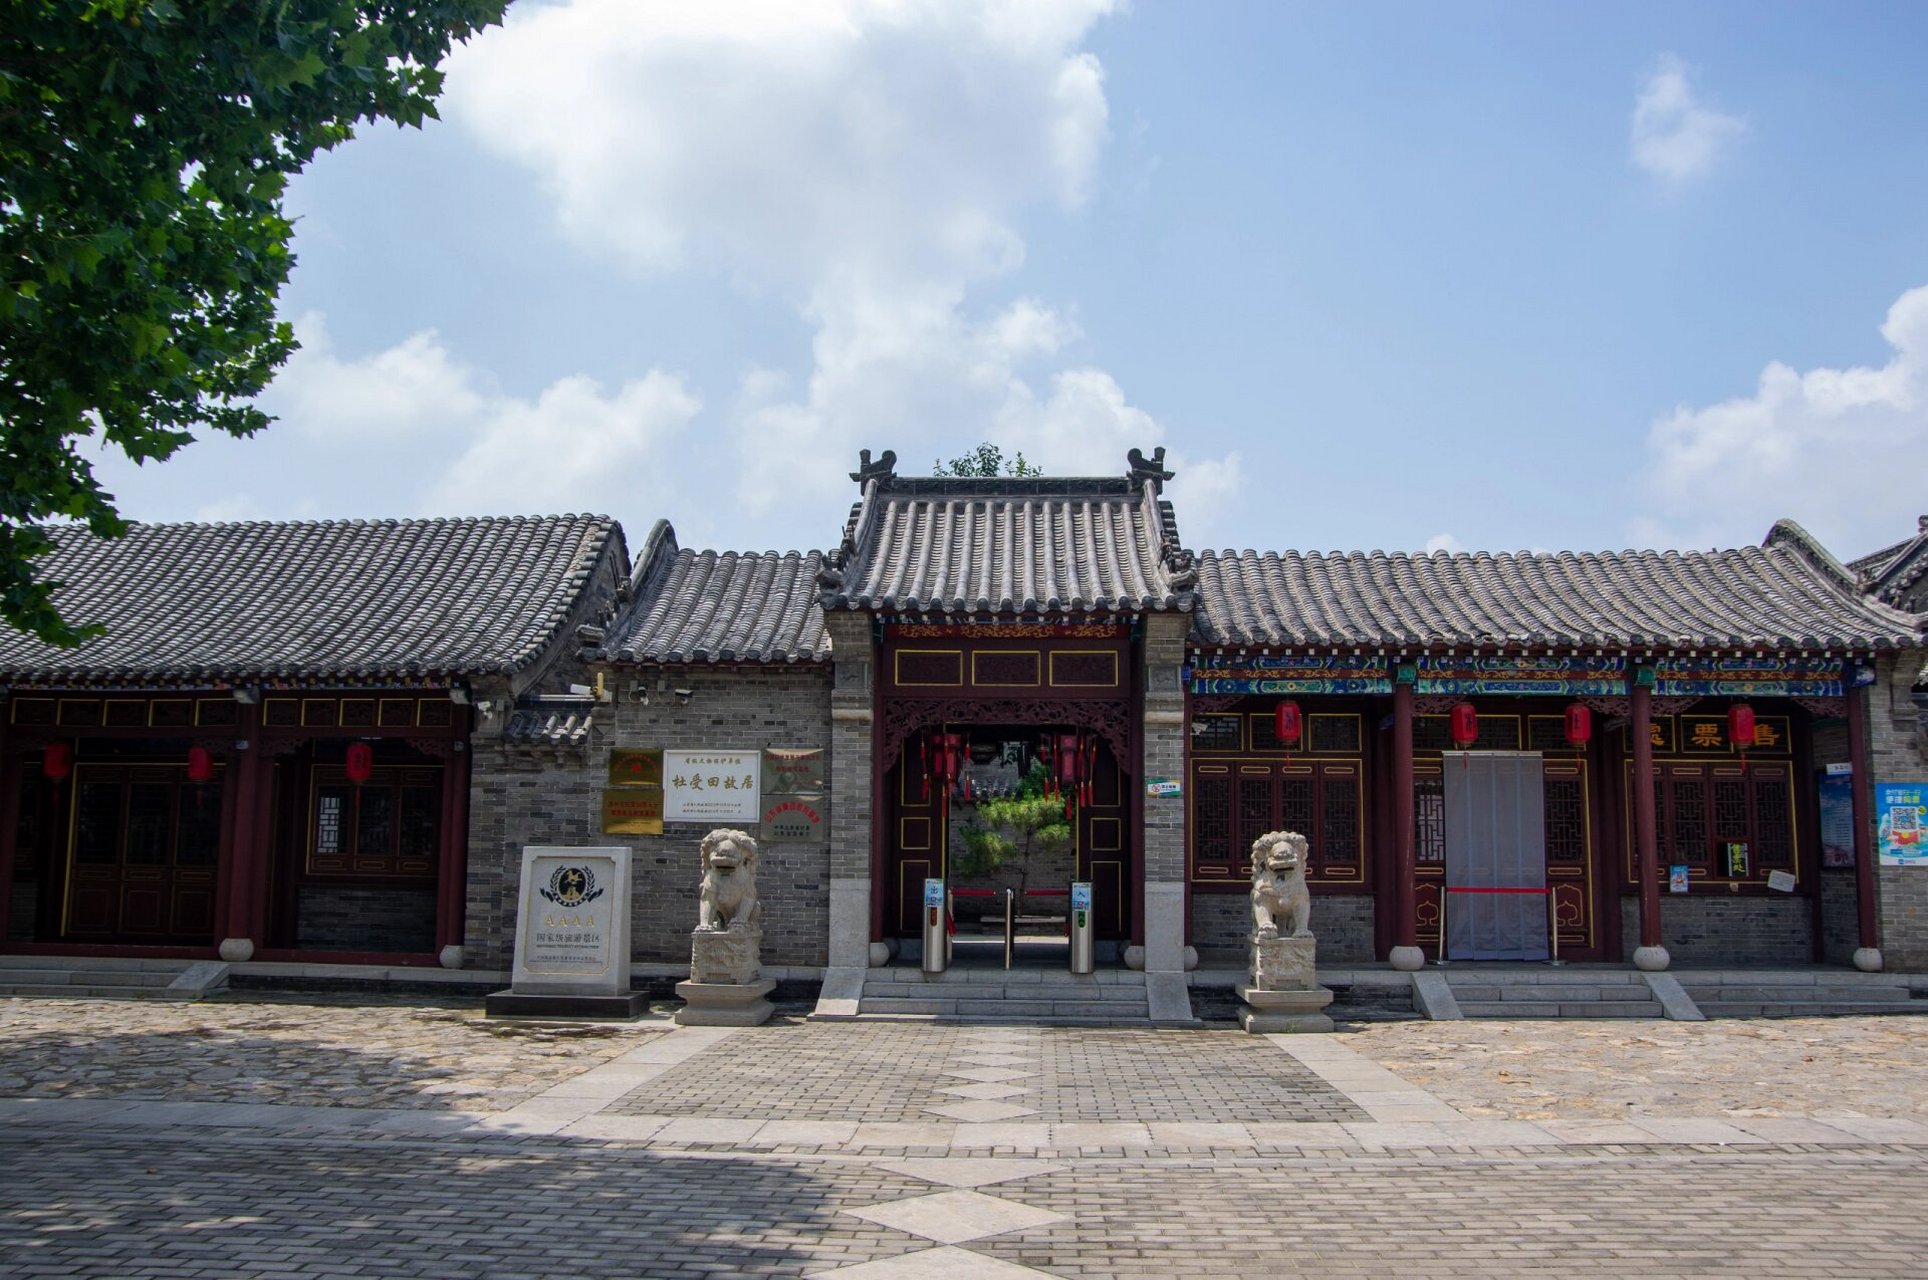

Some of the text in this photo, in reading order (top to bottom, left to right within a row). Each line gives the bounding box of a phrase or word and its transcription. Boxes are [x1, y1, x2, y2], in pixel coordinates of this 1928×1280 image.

[672, 773, 753, 790] 杜受田故居
[536, 933, 600, 943] 国家级旅游景区
